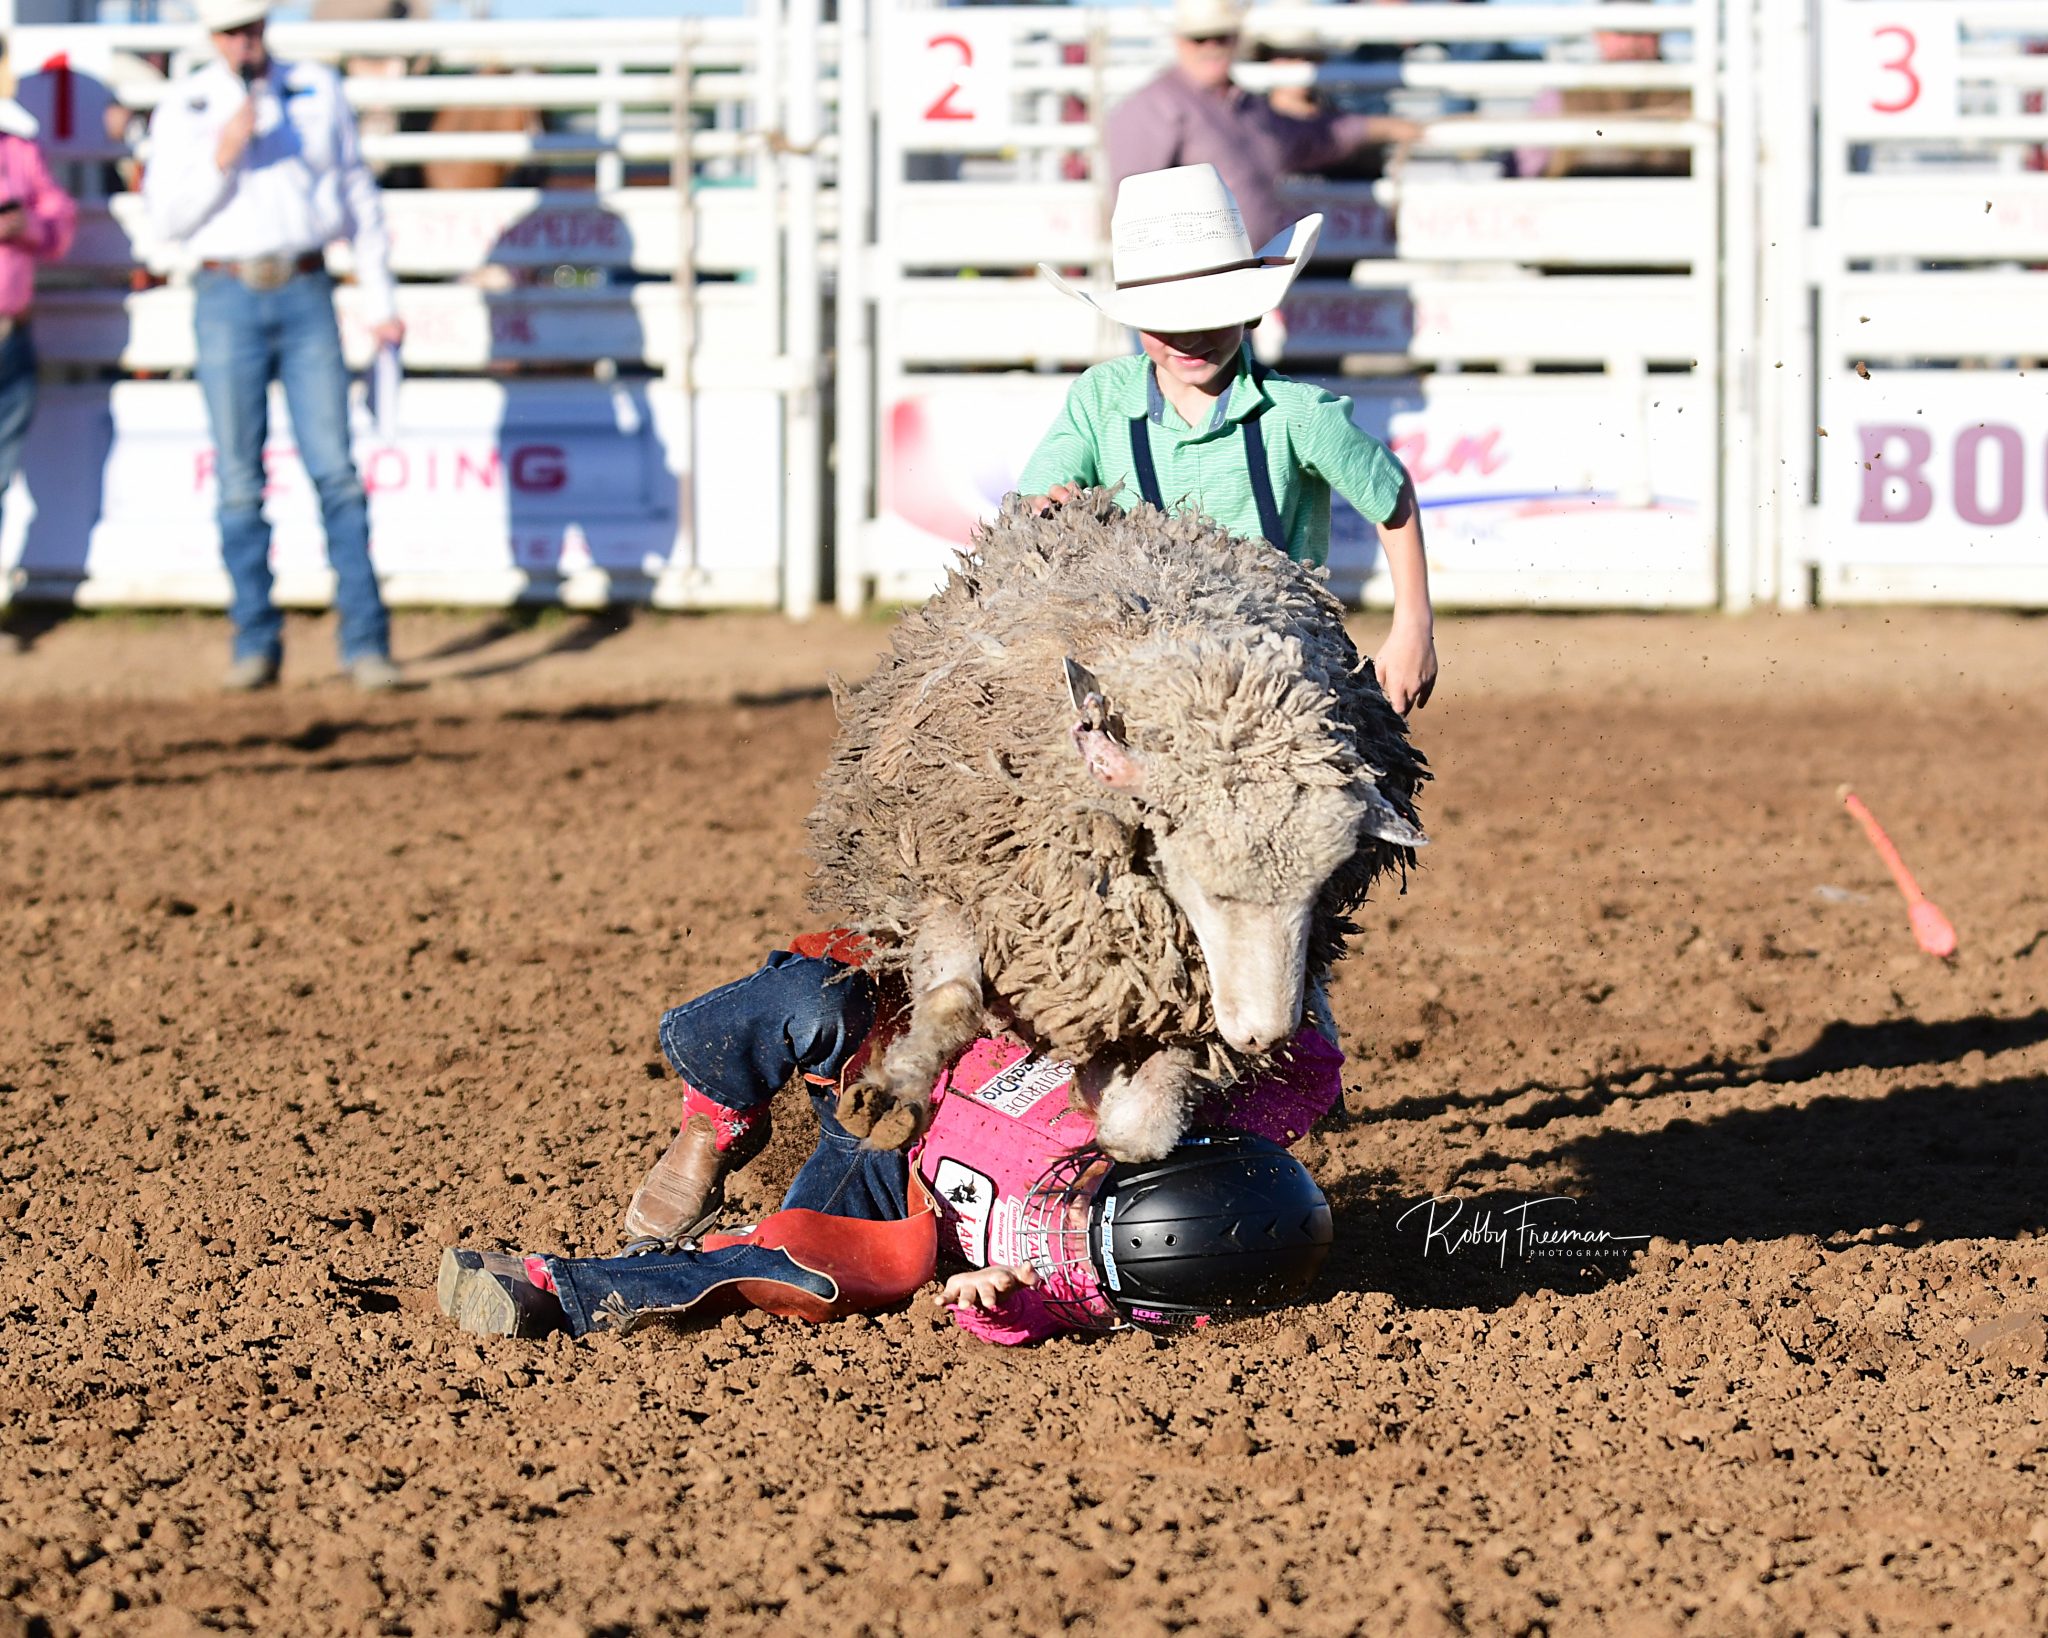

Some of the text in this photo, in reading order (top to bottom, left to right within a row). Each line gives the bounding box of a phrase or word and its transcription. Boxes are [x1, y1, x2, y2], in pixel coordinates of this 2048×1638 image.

[42, 50, 75, 140] 1
[922, 33, 976, 122] 2
[1870, 26, 1922, 113] 3
[1855, 422, 2048, 526] BO
